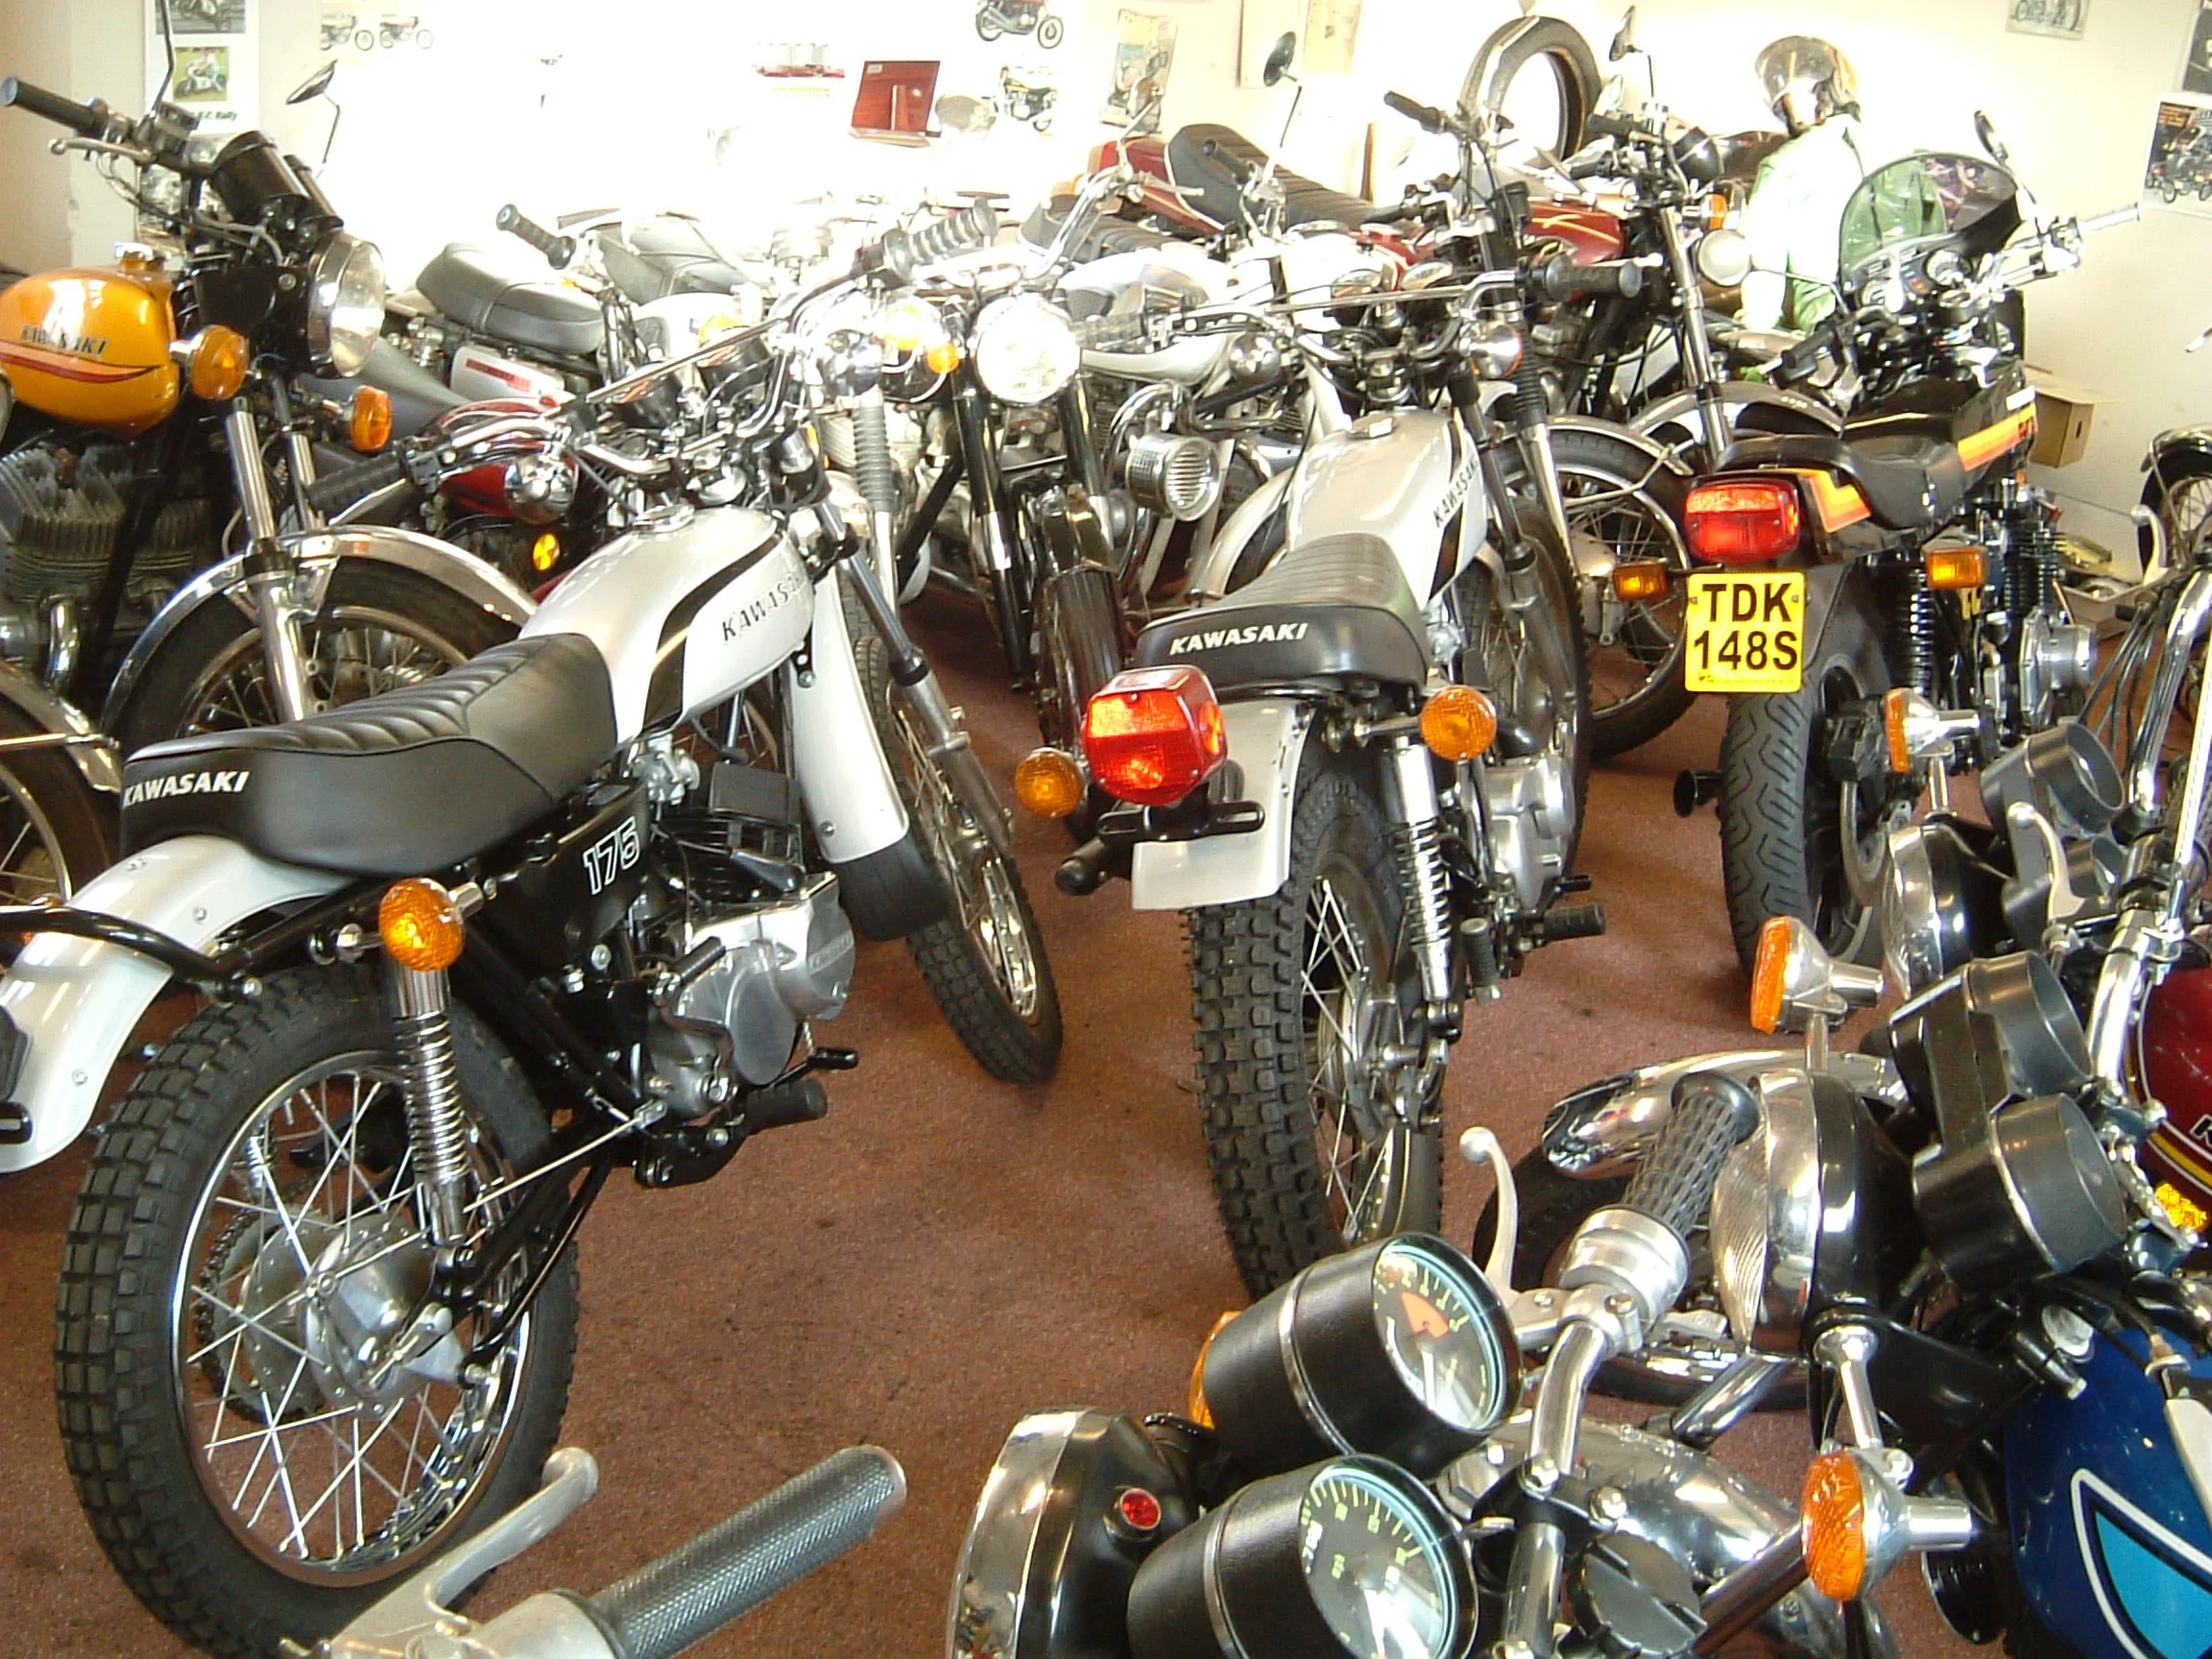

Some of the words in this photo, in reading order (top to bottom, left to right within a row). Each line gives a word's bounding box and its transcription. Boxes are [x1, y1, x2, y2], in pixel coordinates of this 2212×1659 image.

[1702, 583, 1791, 622] TDK
[1169, 623, 1309, 656] KAWASAKI
[1694, 630, 1797, 670] 148S
[126, 771, 250, 809] KAWASAKI
[583, 816, 640, 895] 175
